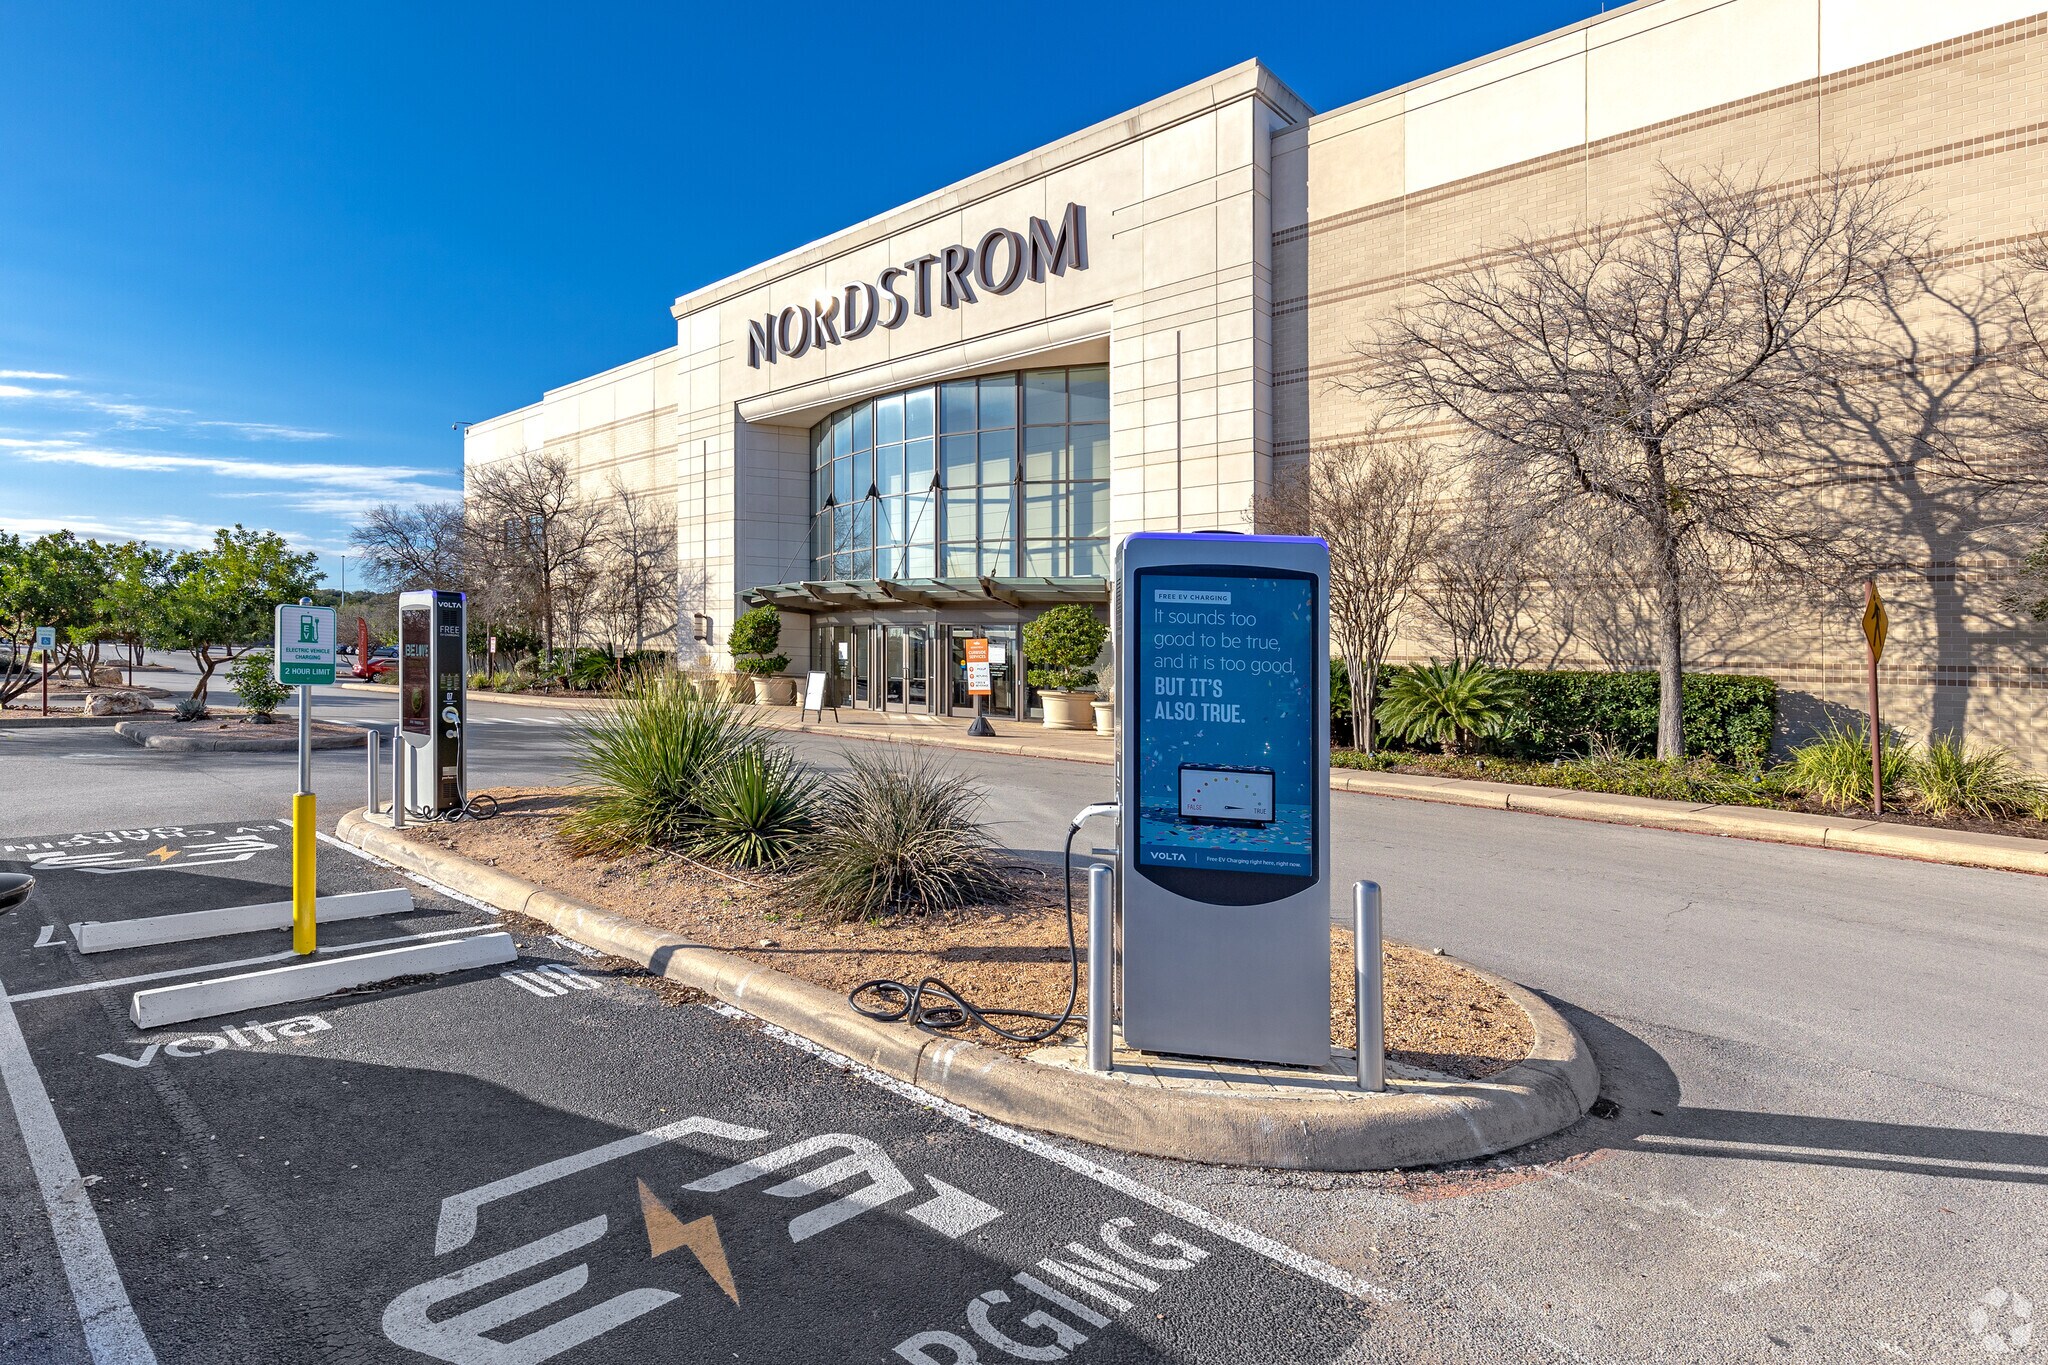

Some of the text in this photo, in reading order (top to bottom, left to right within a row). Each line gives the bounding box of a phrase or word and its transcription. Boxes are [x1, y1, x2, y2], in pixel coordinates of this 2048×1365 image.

[747, 202, 1089, 369] NORDSTROM
[437, 601, 462, 609] VOLTA
[1154, 608, 1257, 627] It sounds too
[440, 625, 460, 634] FREE
[1154, 631, 1281, 652] good to be true,
[285, 667, 290, 675] 2
[291, 667, 311, 675] HOUR
[1154, 653, 1296, 676] and it is too good,
[1155, 676, 1185, 696] BUT
[1154, 701, 1246, 723] ALSO TRUE.
[1150, 851, 1187, 861] VOLTA
[1226, 857, 1249, 865] Charging
[96, 1014, 333, 1068] volta
